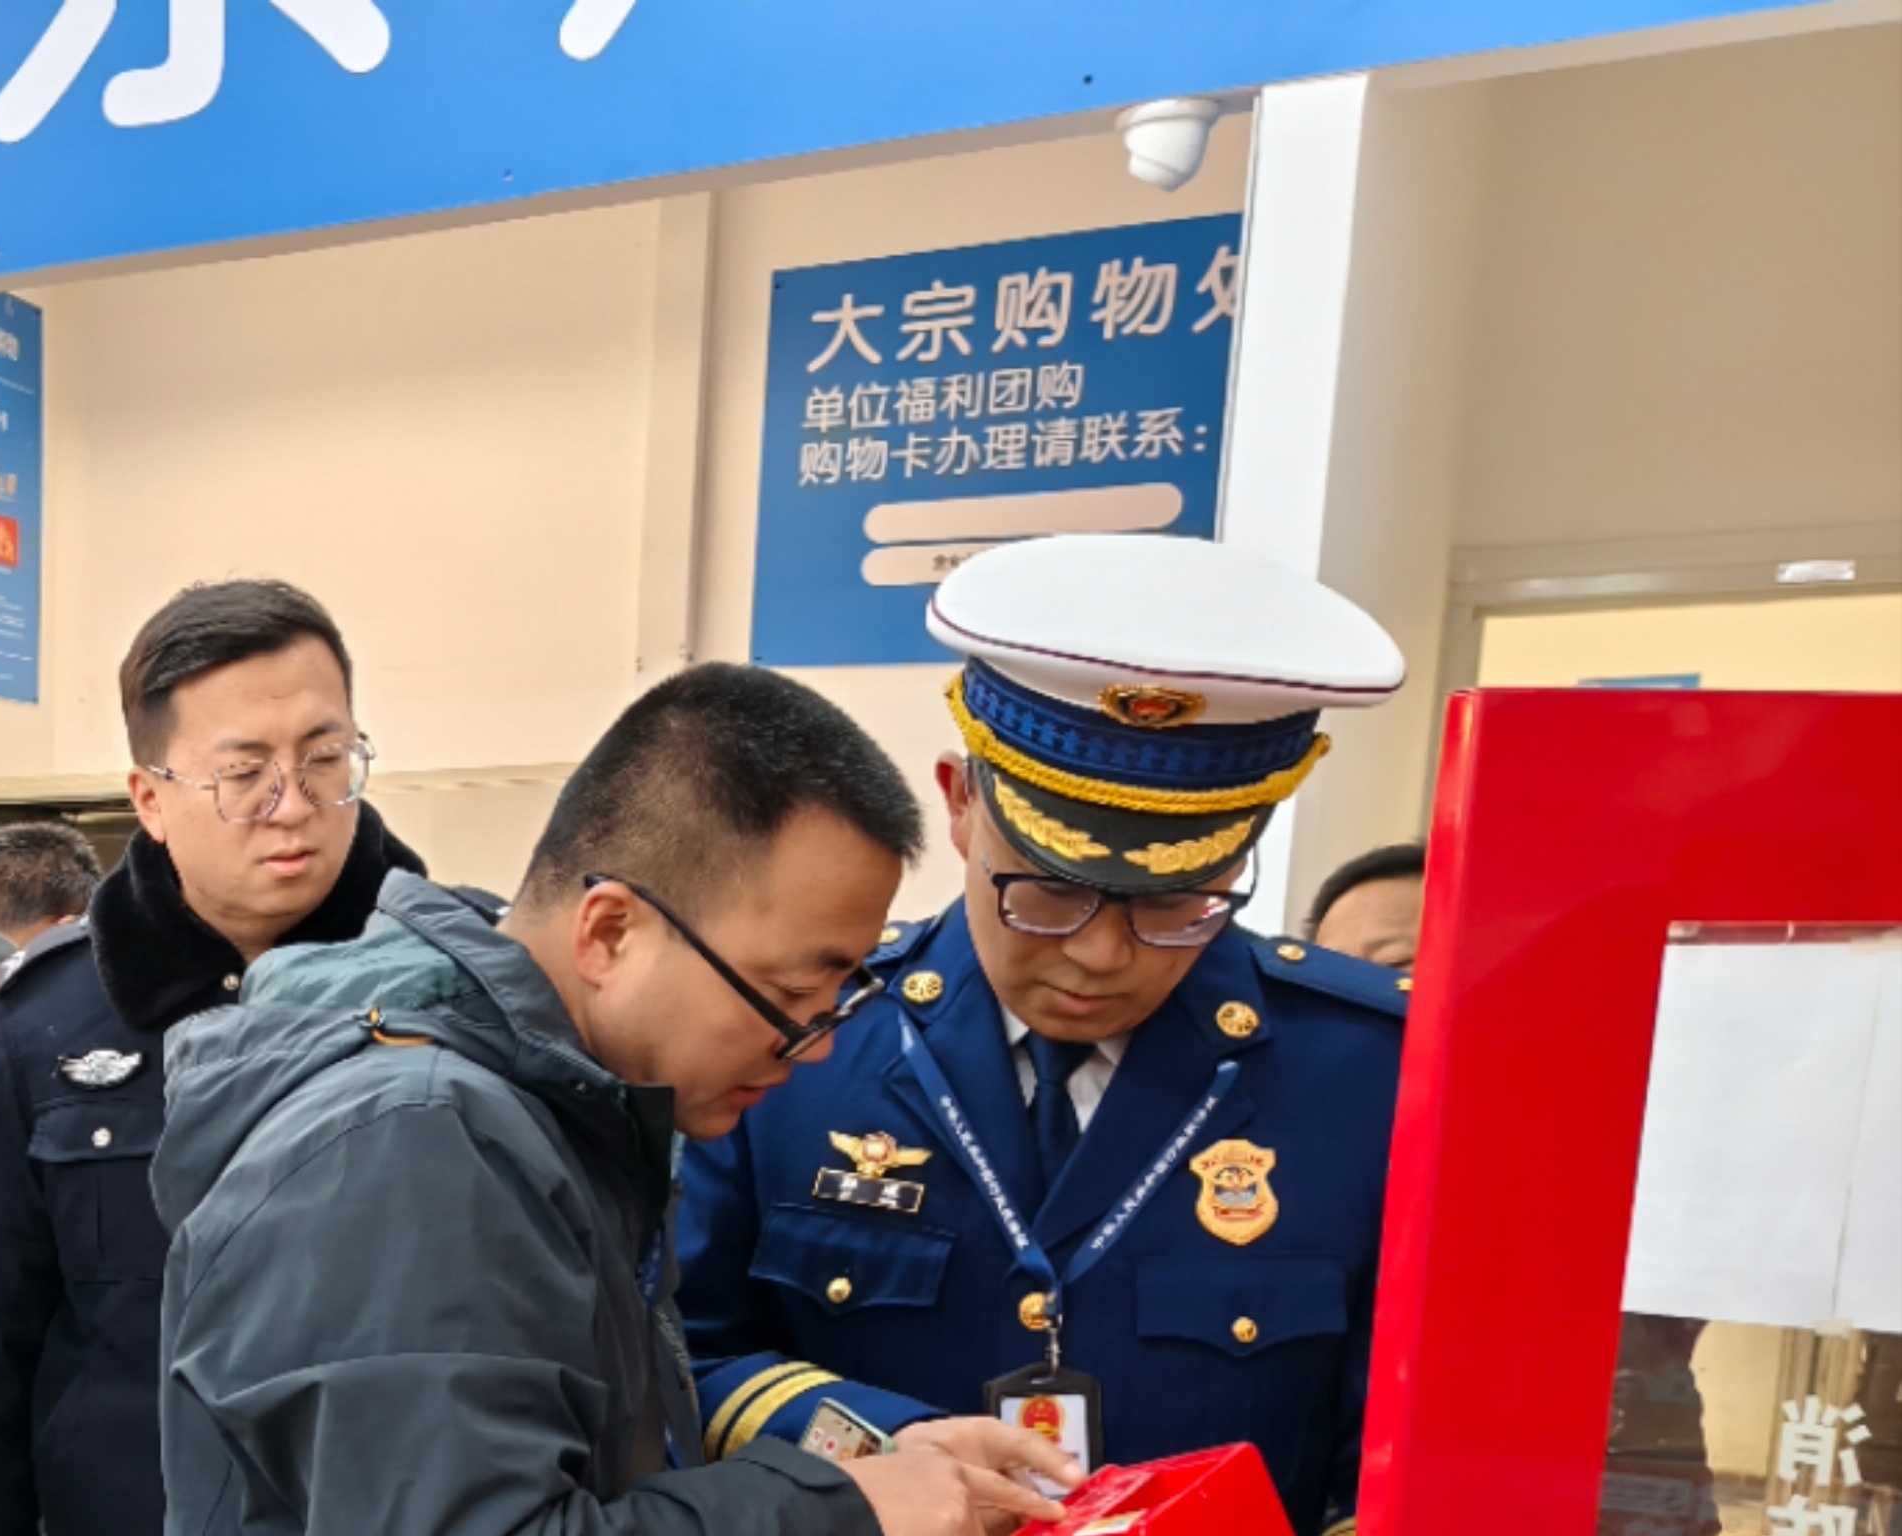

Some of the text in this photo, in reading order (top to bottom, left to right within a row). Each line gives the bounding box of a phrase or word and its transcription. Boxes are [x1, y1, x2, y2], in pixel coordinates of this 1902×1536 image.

[801, 360, 1084, 434] 单位福利团购
[799, 406, 1207, 486] 购物卡办理请联系：
